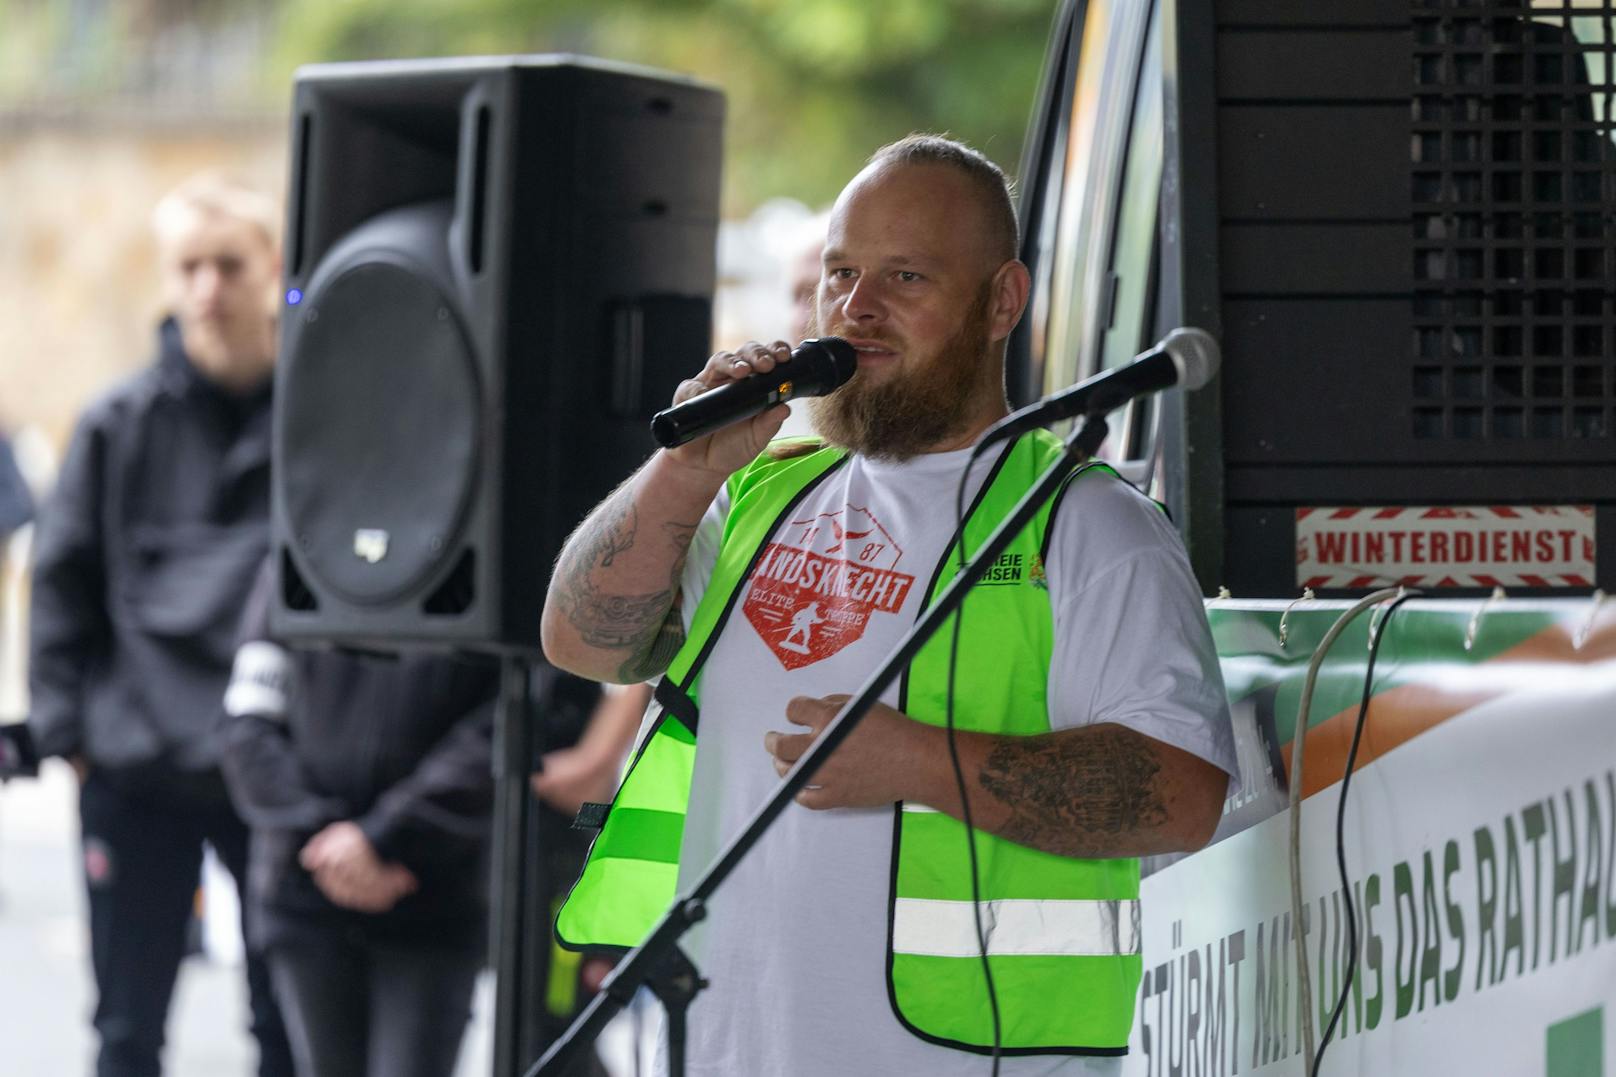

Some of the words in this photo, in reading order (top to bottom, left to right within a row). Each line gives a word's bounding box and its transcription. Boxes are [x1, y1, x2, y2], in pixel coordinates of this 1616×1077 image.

[859, 542, 885, 562] 87
[1314, 530, 1577, 565] WINTERDIENST
[750, 548, 907, 609] ANDSKNECHT
[982, 567, 1022, 581] HSEN
[1142, 919, 1246, 1077] STÜRMT
[1252, 901, 1311, 1069] MIT
[1319, 872, 1384, 1047] UNS
[1393, 838, 1465, 1022] DAS
